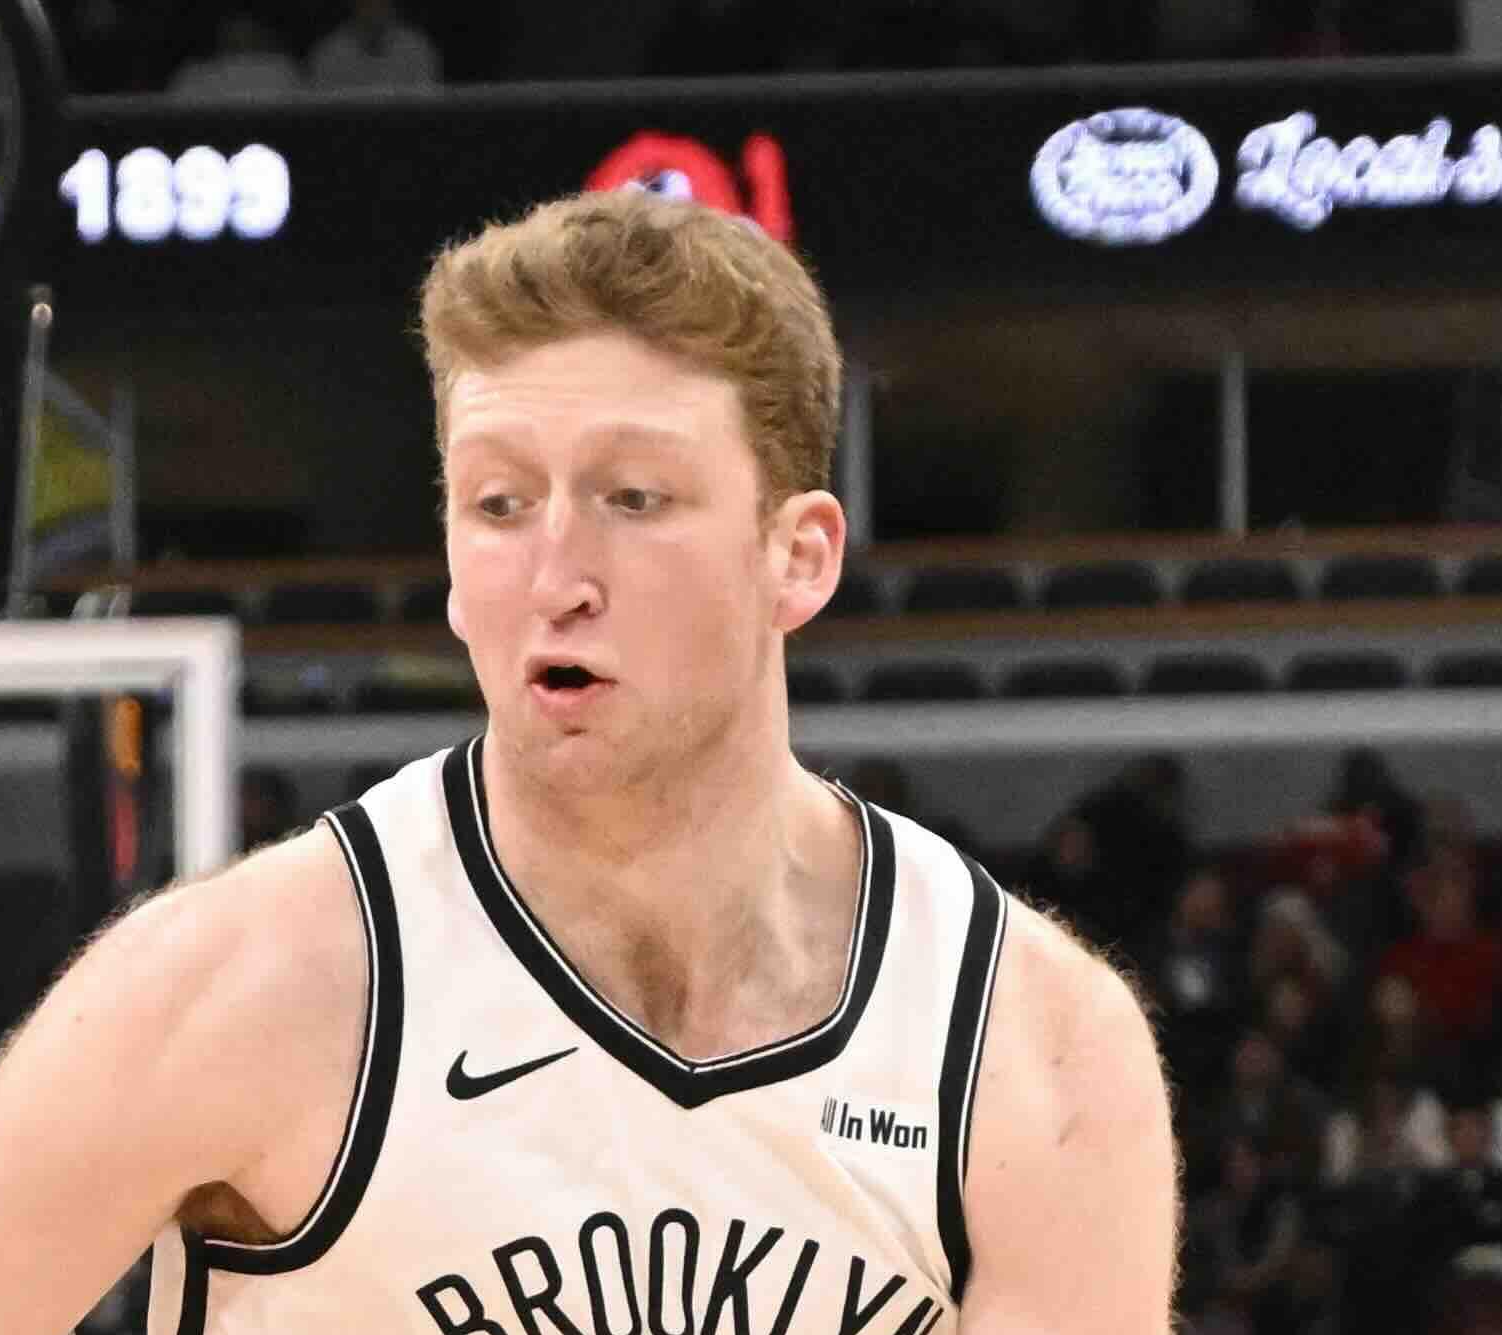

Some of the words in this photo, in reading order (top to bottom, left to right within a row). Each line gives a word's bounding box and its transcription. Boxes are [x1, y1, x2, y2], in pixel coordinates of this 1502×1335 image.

[1234, 110, 1451, 230] Local
[839, 1102, 863, 1141] In
[870, 1108, 928, 1150] Won
